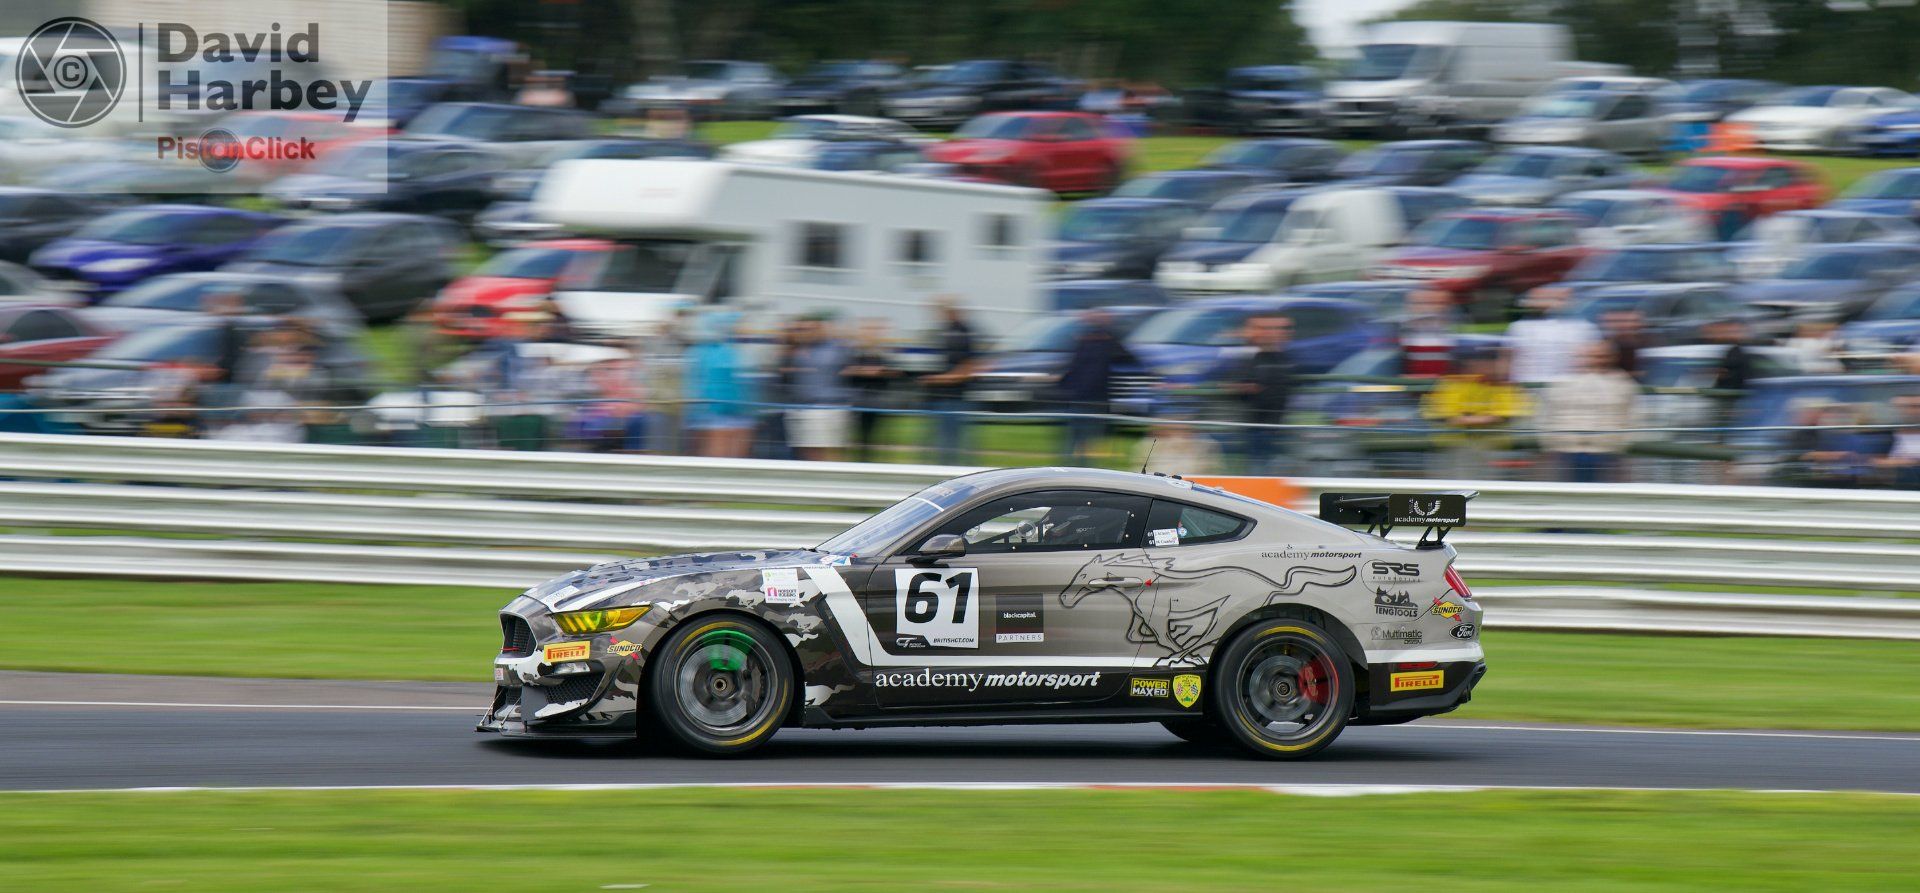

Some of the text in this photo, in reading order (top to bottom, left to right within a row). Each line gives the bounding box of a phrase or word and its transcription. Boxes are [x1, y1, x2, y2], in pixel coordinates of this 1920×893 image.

[1394, 516, 1426, 524] academy
[1261, 550, 1362, 560] academy motorsport
[1371, 562, 1420, 577] SRS
[904, 572, 973, 625] 61
[1432, 606, 1463, 615] SUNOCO
[1382, 629, 1423, 638] Multimatic
[1457, 624, 1475, 638] Ford
[547, 645, 586, 660] PIRELLI
[608, 644, 643, 653] SUNOCO
[875, 668, 1101, 692] academy motorsport
[1133, 680, 1168, 689] POWER
[1394, 674, 1440, 688] PIRELLI
[1132, 687, 1167, 697] MAXED
